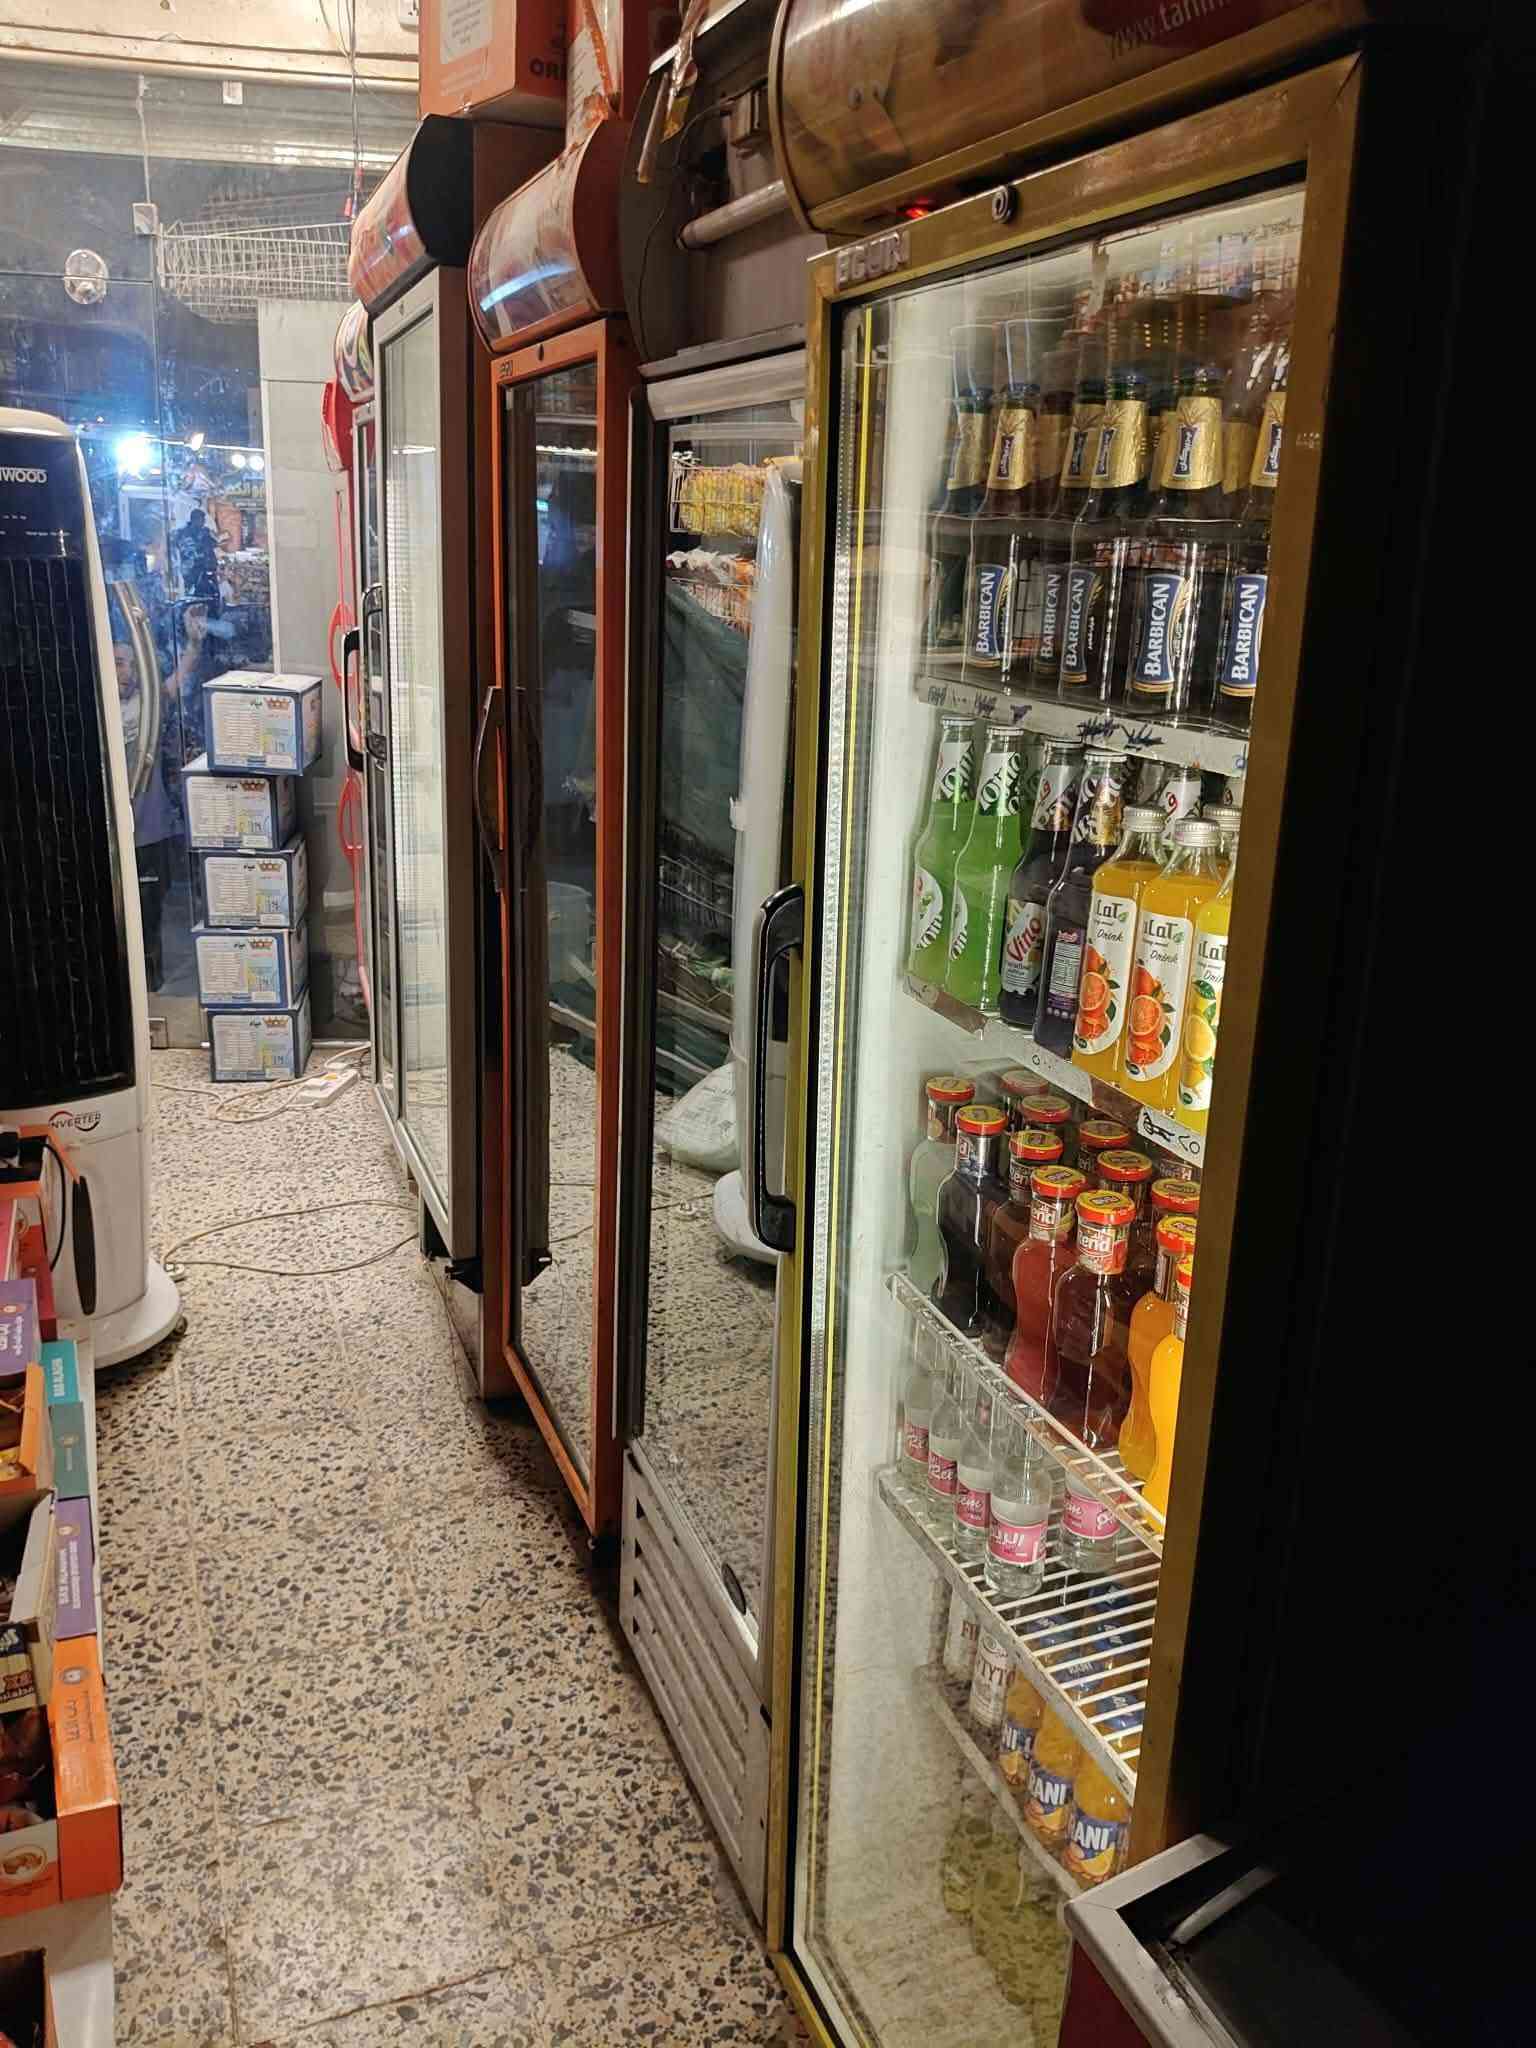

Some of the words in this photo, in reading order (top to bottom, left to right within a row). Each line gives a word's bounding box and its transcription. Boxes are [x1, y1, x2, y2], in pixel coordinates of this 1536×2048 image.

[976, 571, 996, 653] BARBICAN
[1040, 573, 1062, 658] BARBICAN
[1066, 578, 1085, 667] BARBICAN
[1143, 583, 1171, 677] BARBICAN
[1231, 583, 1259, 681] BARBICAN
[1096, 928, 1125, 943] Drink
[1150, 949, 1178, 965] Drink
